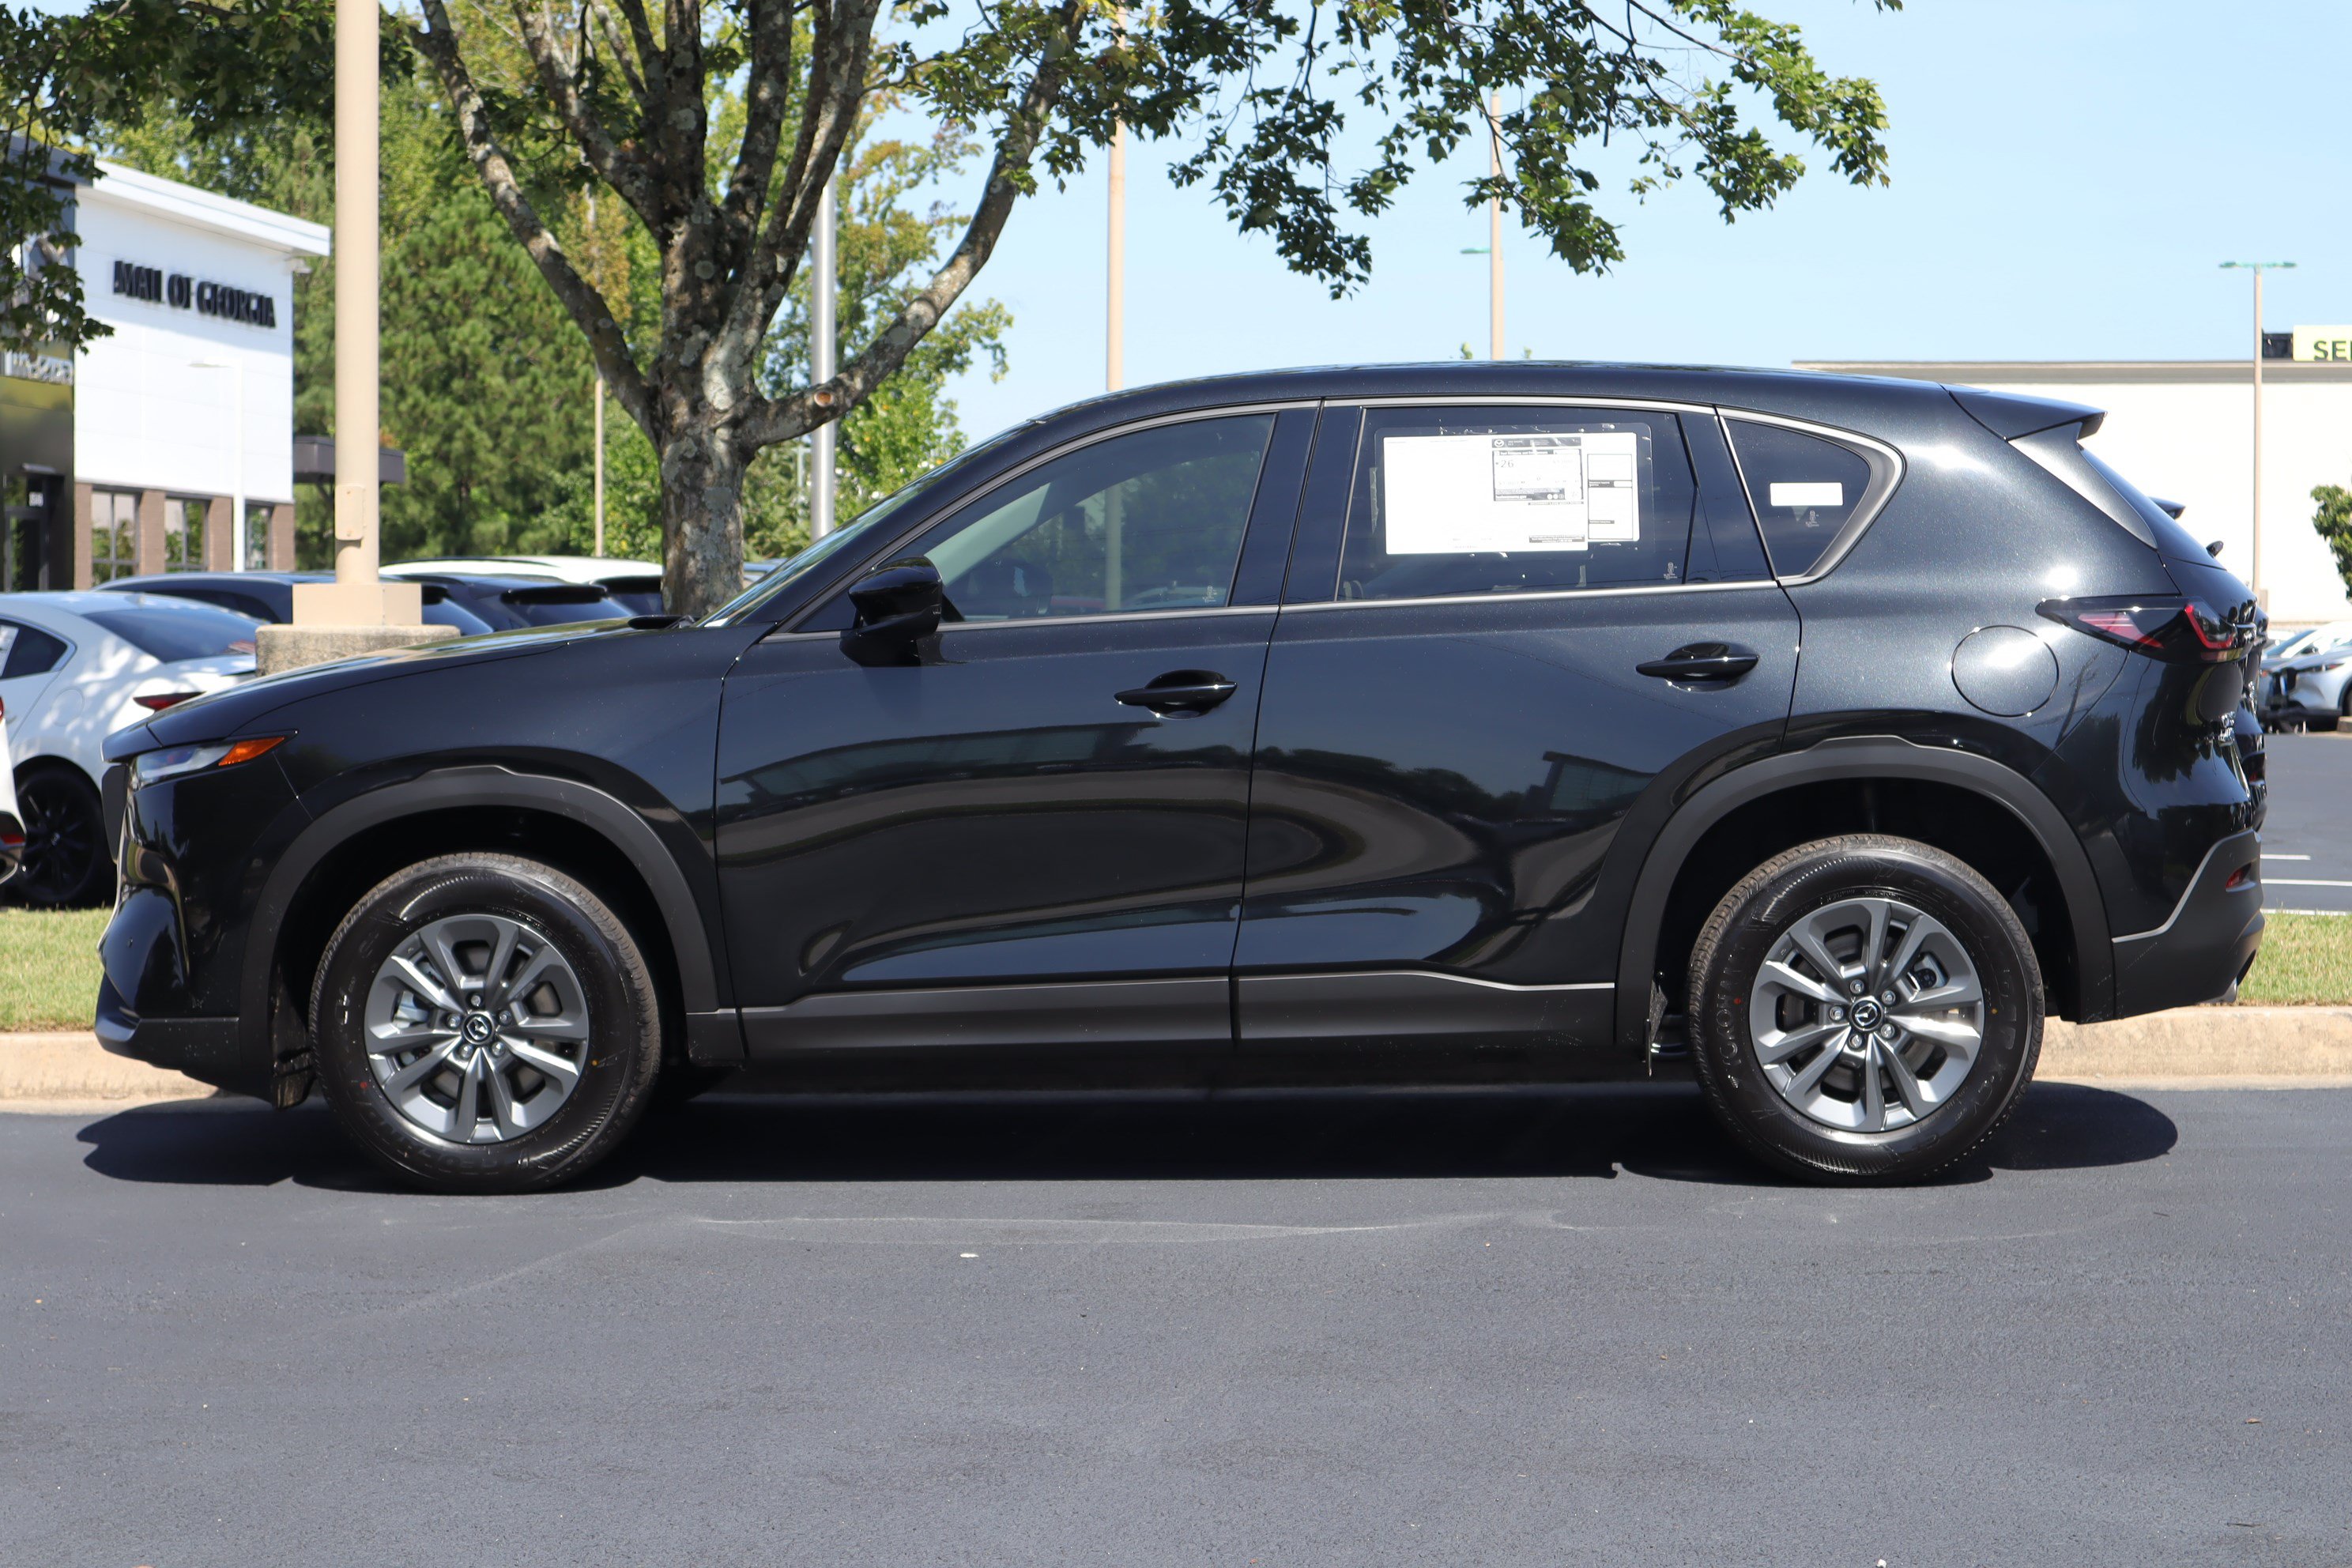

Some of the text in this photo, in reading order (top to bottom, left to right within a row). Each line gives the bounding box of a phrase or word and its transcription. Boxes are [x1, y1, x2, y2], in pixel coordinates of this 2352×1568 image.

[113, 260, 276, 328] MALL OF GEORGIA
[2313, 340, 2352, 363] SE
